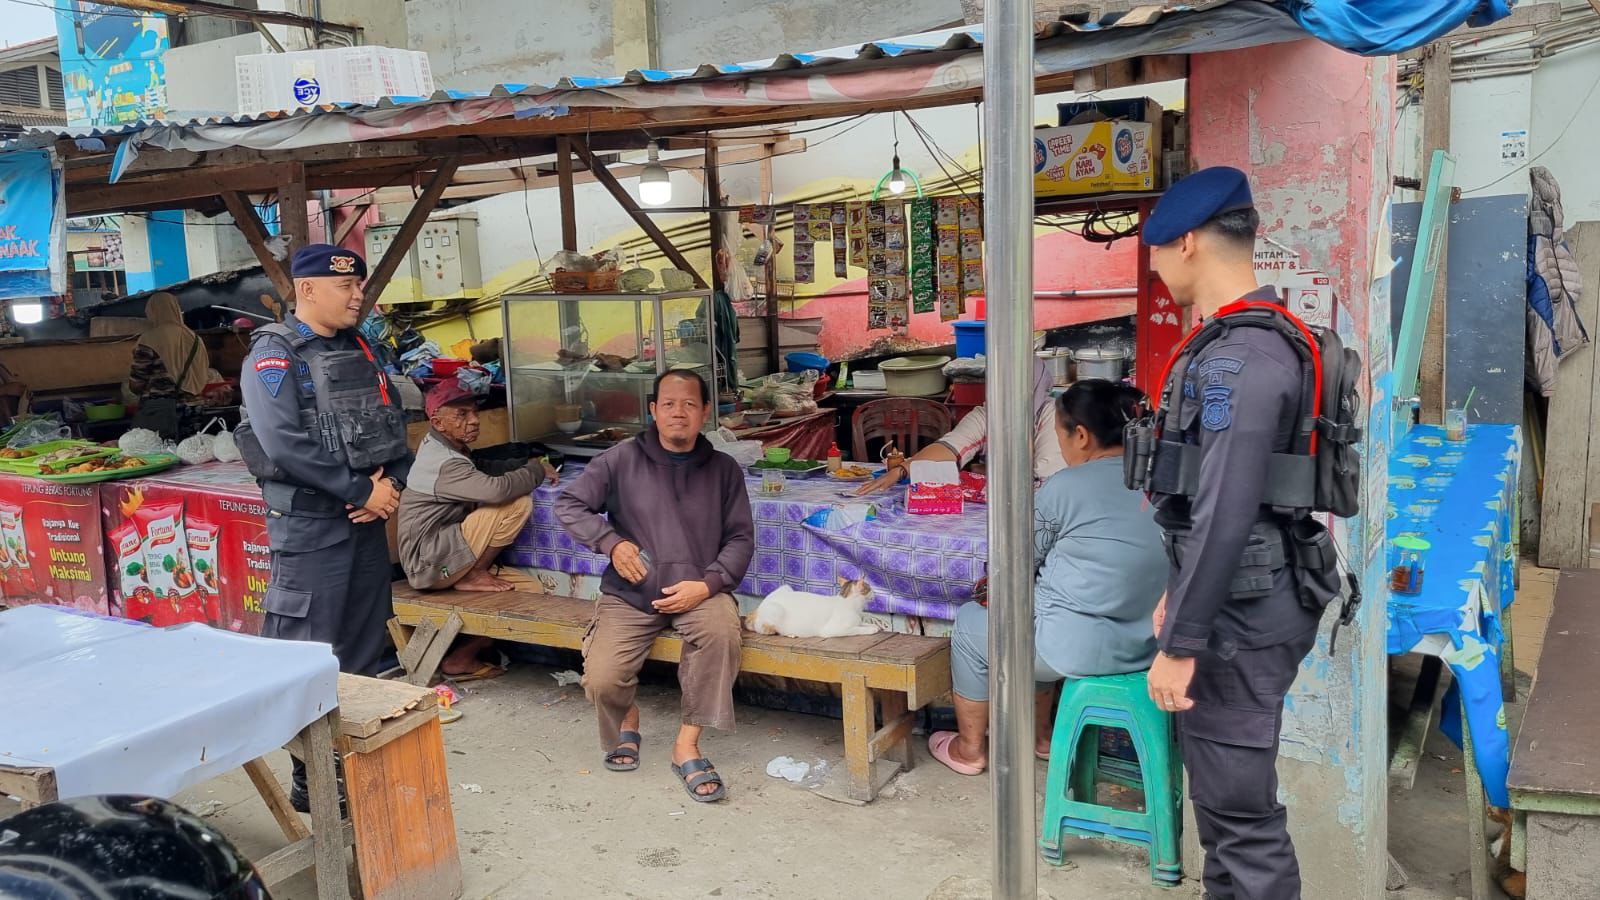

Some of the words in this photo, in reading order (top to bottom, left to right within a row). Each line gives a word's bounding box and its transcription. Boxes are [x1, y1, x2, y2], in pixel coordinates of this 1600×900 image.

[1075, 159, 1092, 169] KARI
[1075, 167, 1095, 177] AYAM
[1254, 251, 1283, 260] HITAM
[1253, 261, 1286, 270] IKMAT
[1288, 261, 1297, 270] &
[22, 483, 44, 494] TEPUNG
[45, 485, 63, 495] BERAS
[63, 486, 93, 497] FORTUNE
[218, 499, 247, 513] TEPUNG
[67, 519, 80, 530] Kue
[47, 532, 80, 542] Tradisional
[150, 525, 172, 537] Fortune
[242, 540, 270, 556] Rajanya
[49, 547, 86, 566] Untung
[246, 557, 271, 570] Tradisi
[48, 565, 92, 581] Maksimal
